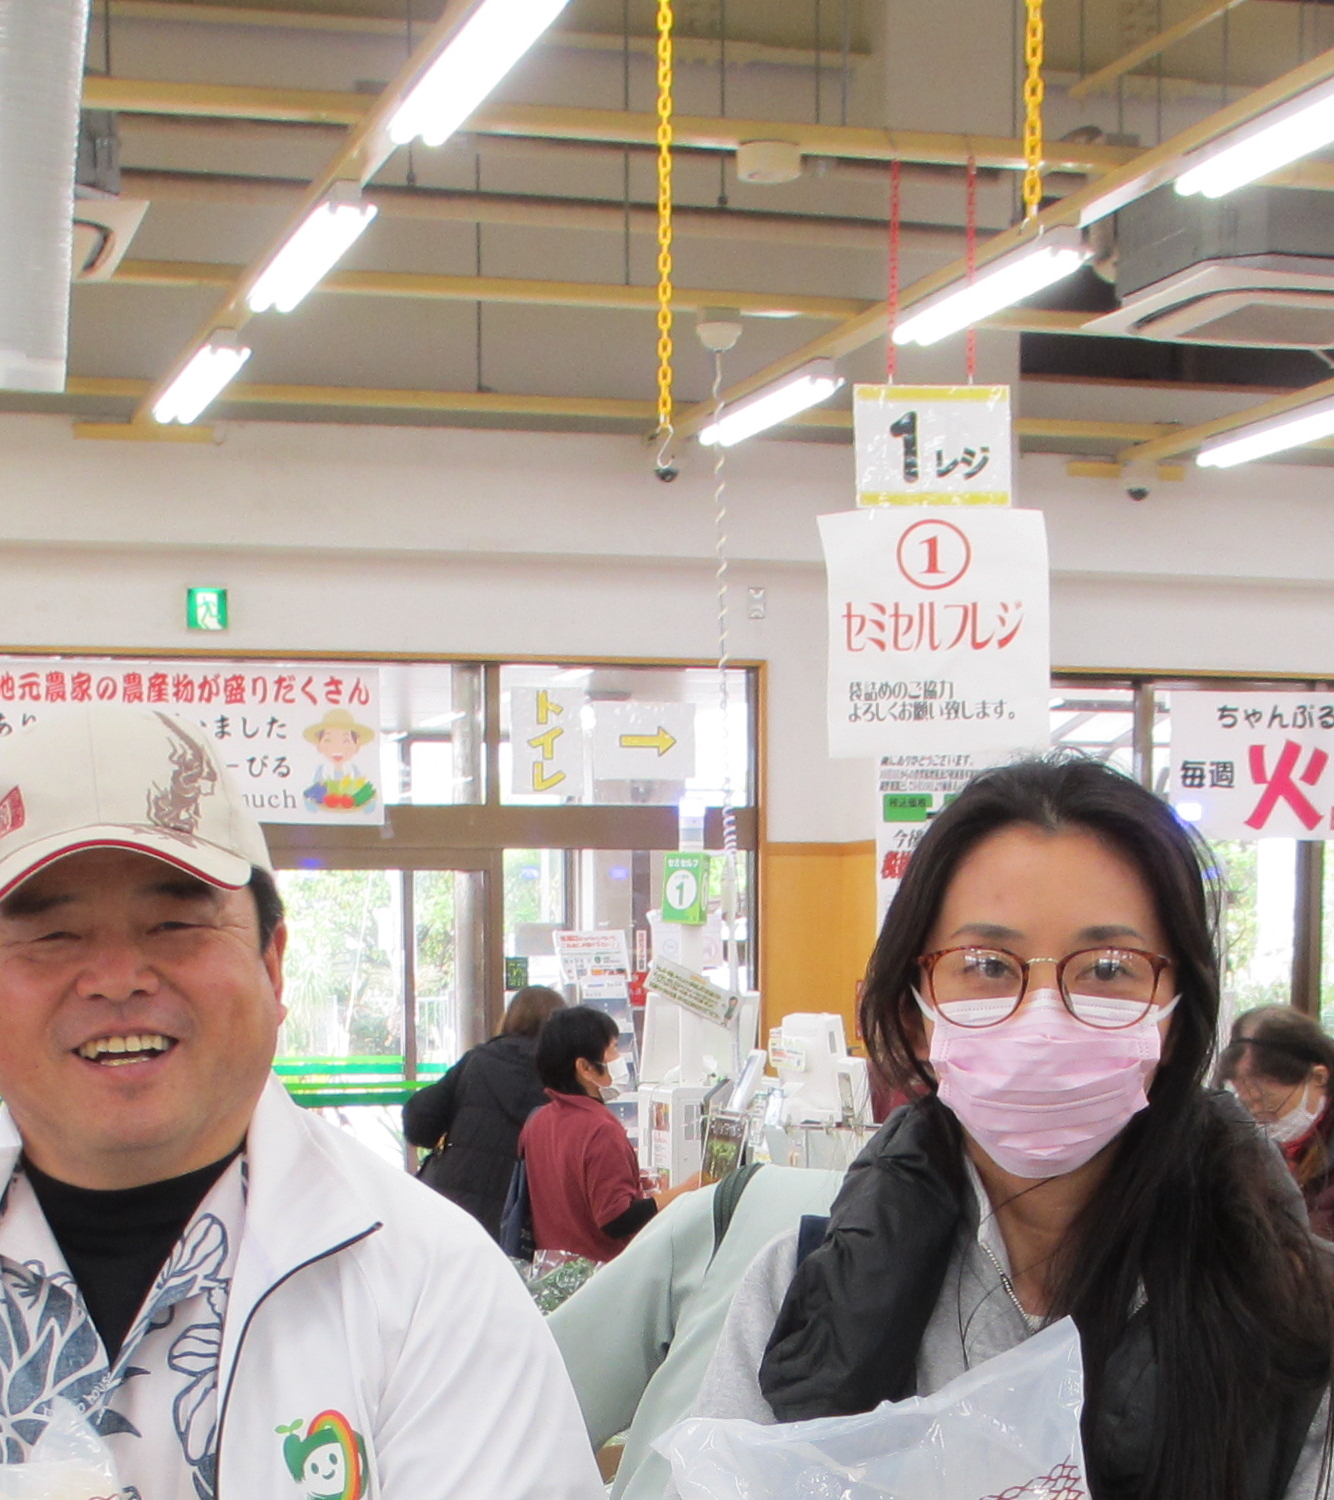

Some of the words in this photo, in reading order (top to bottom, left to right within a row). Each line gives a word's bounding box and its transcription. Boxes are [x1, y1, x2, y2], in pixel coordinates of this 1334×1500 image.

[841, 601, 1024, 652] セミセルフレジ
[848, 680, 955, 701] 袋詰めのご協力
[848, 699, 1016, 723] よろしくお願い致します。
[533, 689, 566, 792] トイレ
[1180, 759, 1236, 790] 毎週
[667, 858, 699, 868] セミセルフ
